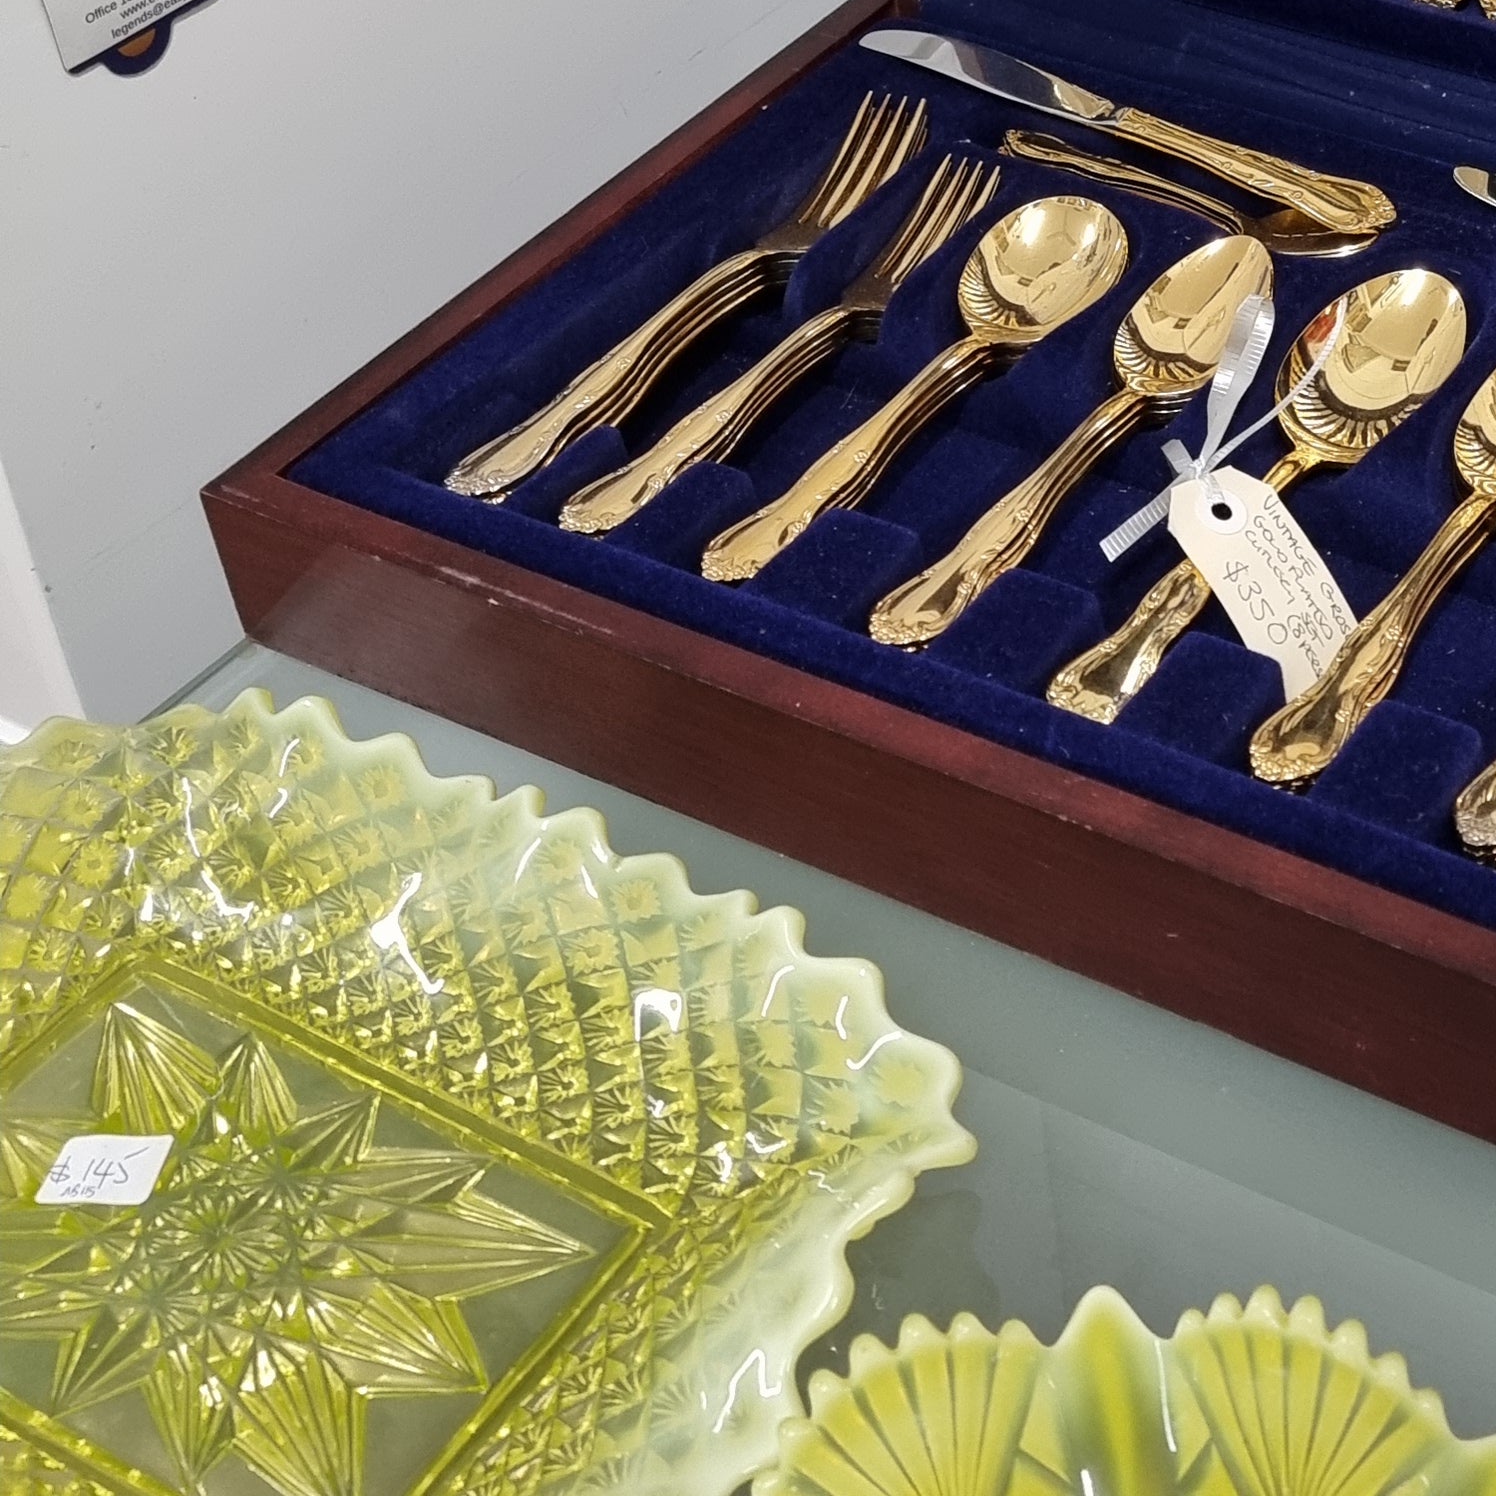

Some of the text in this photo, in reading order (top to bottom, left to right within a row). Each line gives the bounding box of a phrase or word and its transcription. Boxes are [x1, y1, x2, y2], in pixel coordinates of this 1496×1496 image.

[85, 0, 118, 25] Office
[1263, 494, 1317, 577] VINTAGE
[1222, 561, 1288, 645] $350
